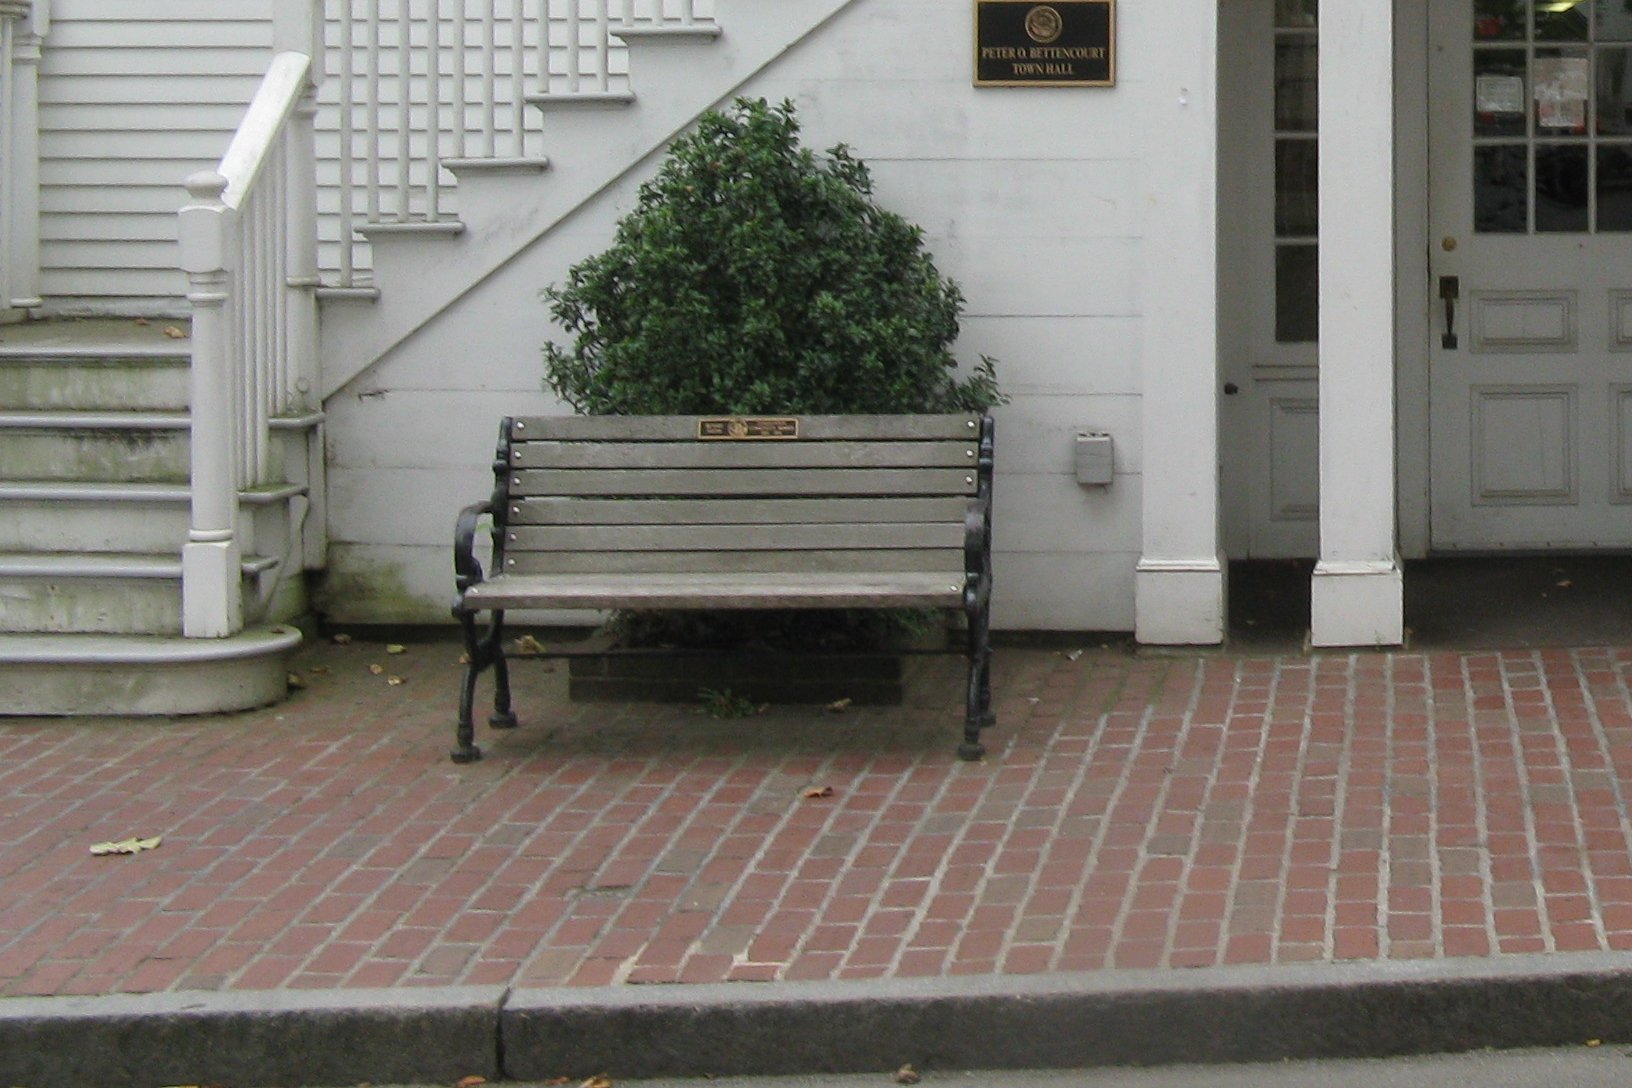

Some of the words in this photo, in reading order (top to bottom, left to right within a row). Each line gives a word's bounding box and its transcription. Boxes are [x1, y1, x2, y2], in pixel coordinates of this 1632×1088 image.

[981, 46, 1016, 59] PETER
[1029, 46, 1106, 59] BETTENCOURT
[1012, 63, 1044, 75] TOWN
[1045, 63, 1074, 75] HALL
